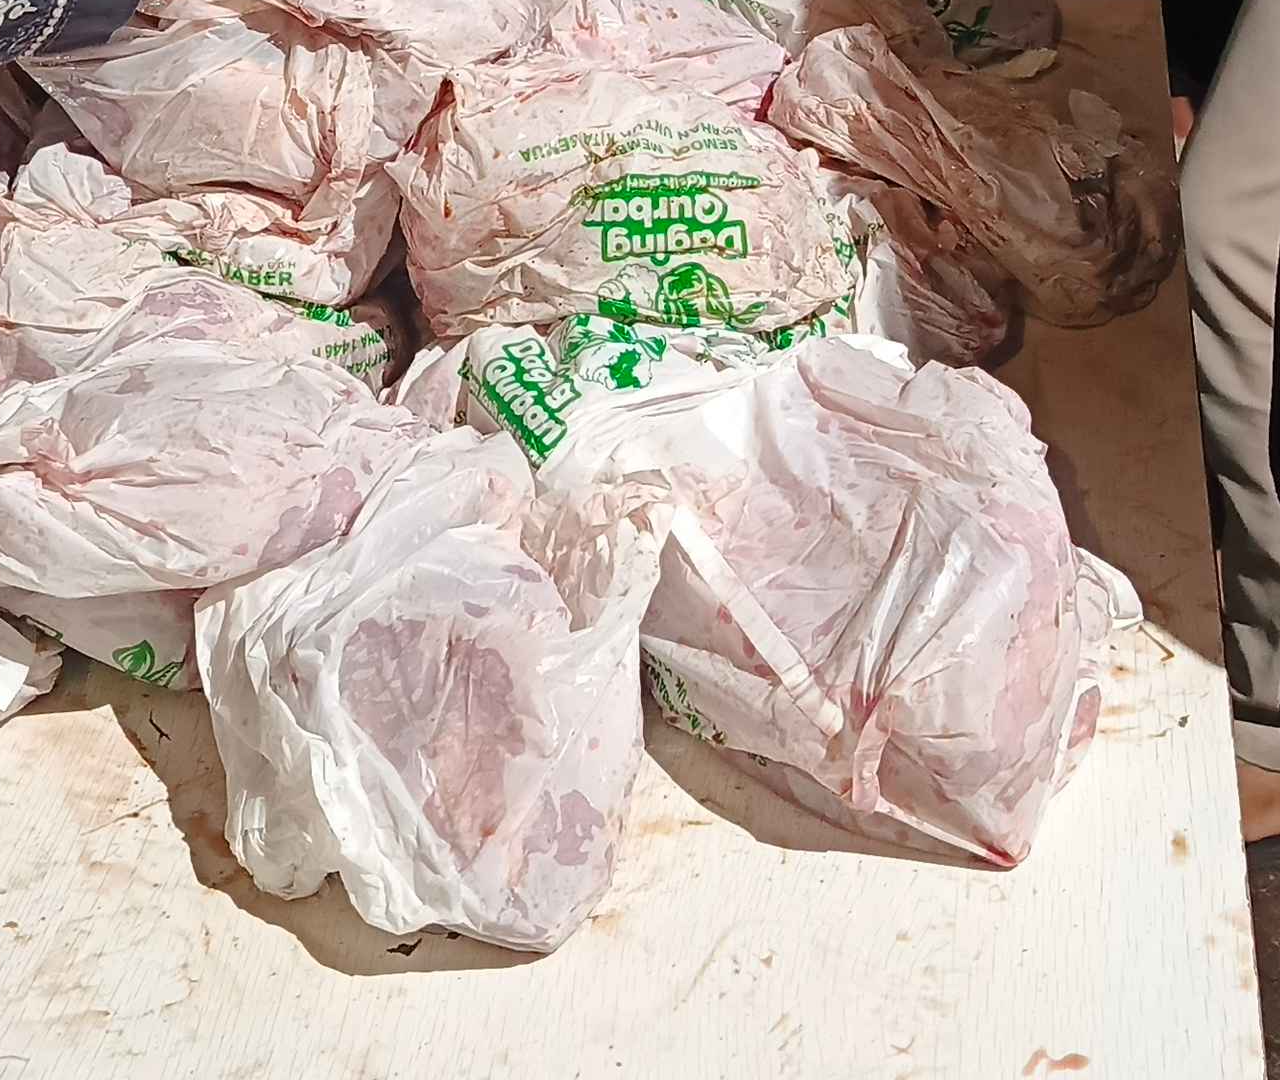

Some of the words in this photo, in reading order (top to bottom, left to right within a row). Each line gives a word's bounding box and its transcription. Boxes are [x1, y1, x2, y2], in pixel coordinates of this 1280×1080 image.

[606, 222, 745, 262] Daging
[324, 338, 358, 358] 1446
[507, 338, 575, 410] Dagg
[484, 357, 567, 447] Qurban
